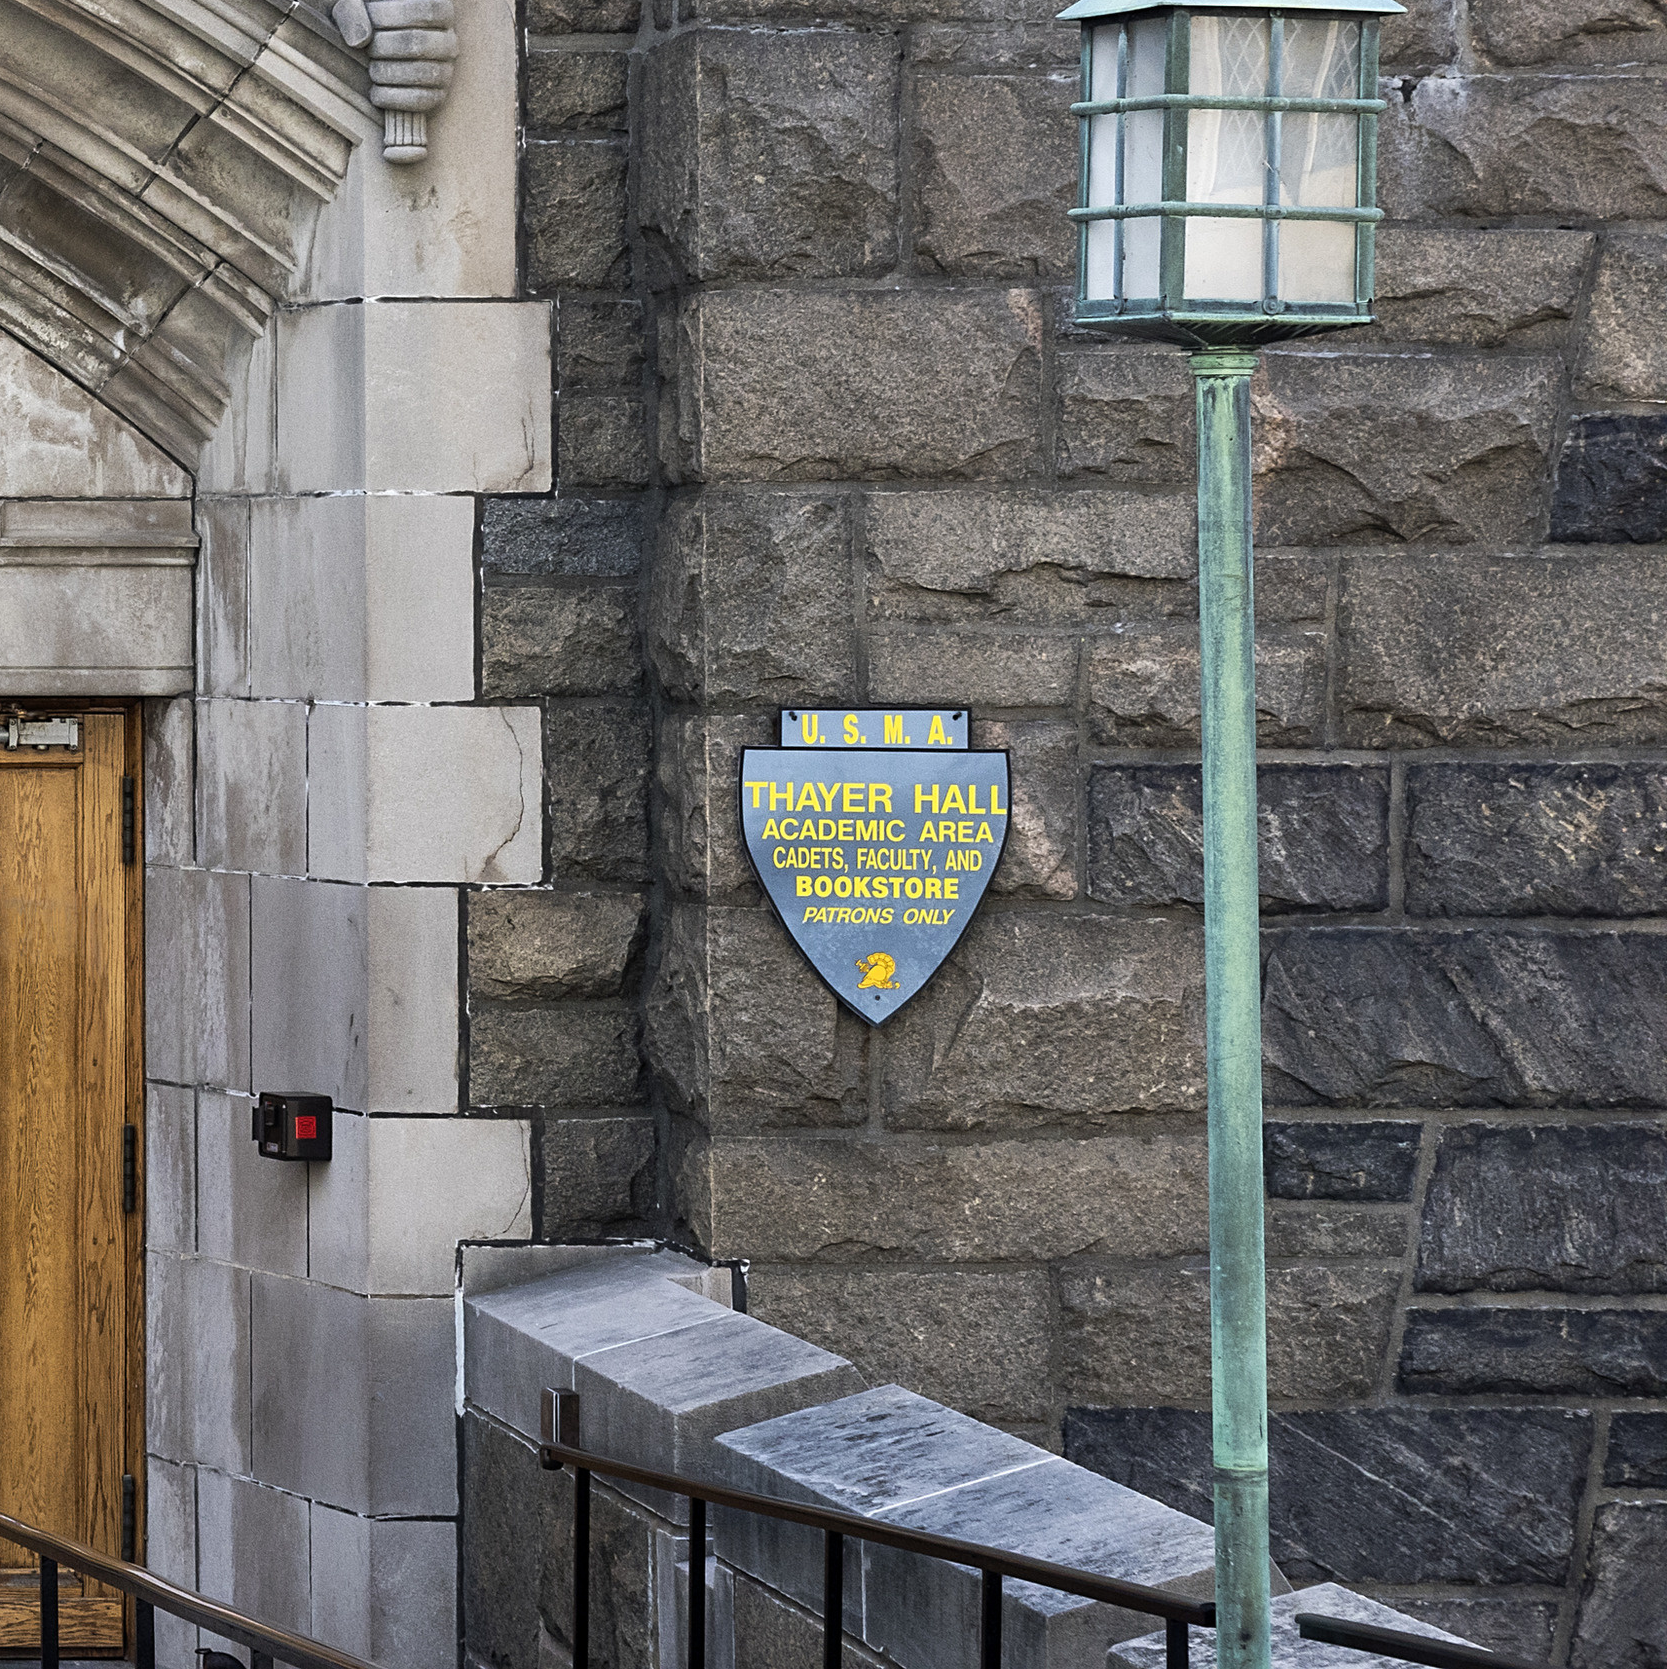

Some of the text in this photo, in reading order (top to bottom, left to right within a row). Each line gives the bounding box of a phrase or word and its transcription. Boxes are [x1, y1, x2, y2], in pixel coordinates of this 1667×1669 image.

[744, 781, 1008, 815] THAYER HALL
[761, 818, 994, 843] ACADEMIC AREA
[773, 846, 983, 874] CADETS, FACULTY, AND
[795, 875, 959, 900] BOOKSTORE
[802, 906, 955, 925] PATRONS ONLY
